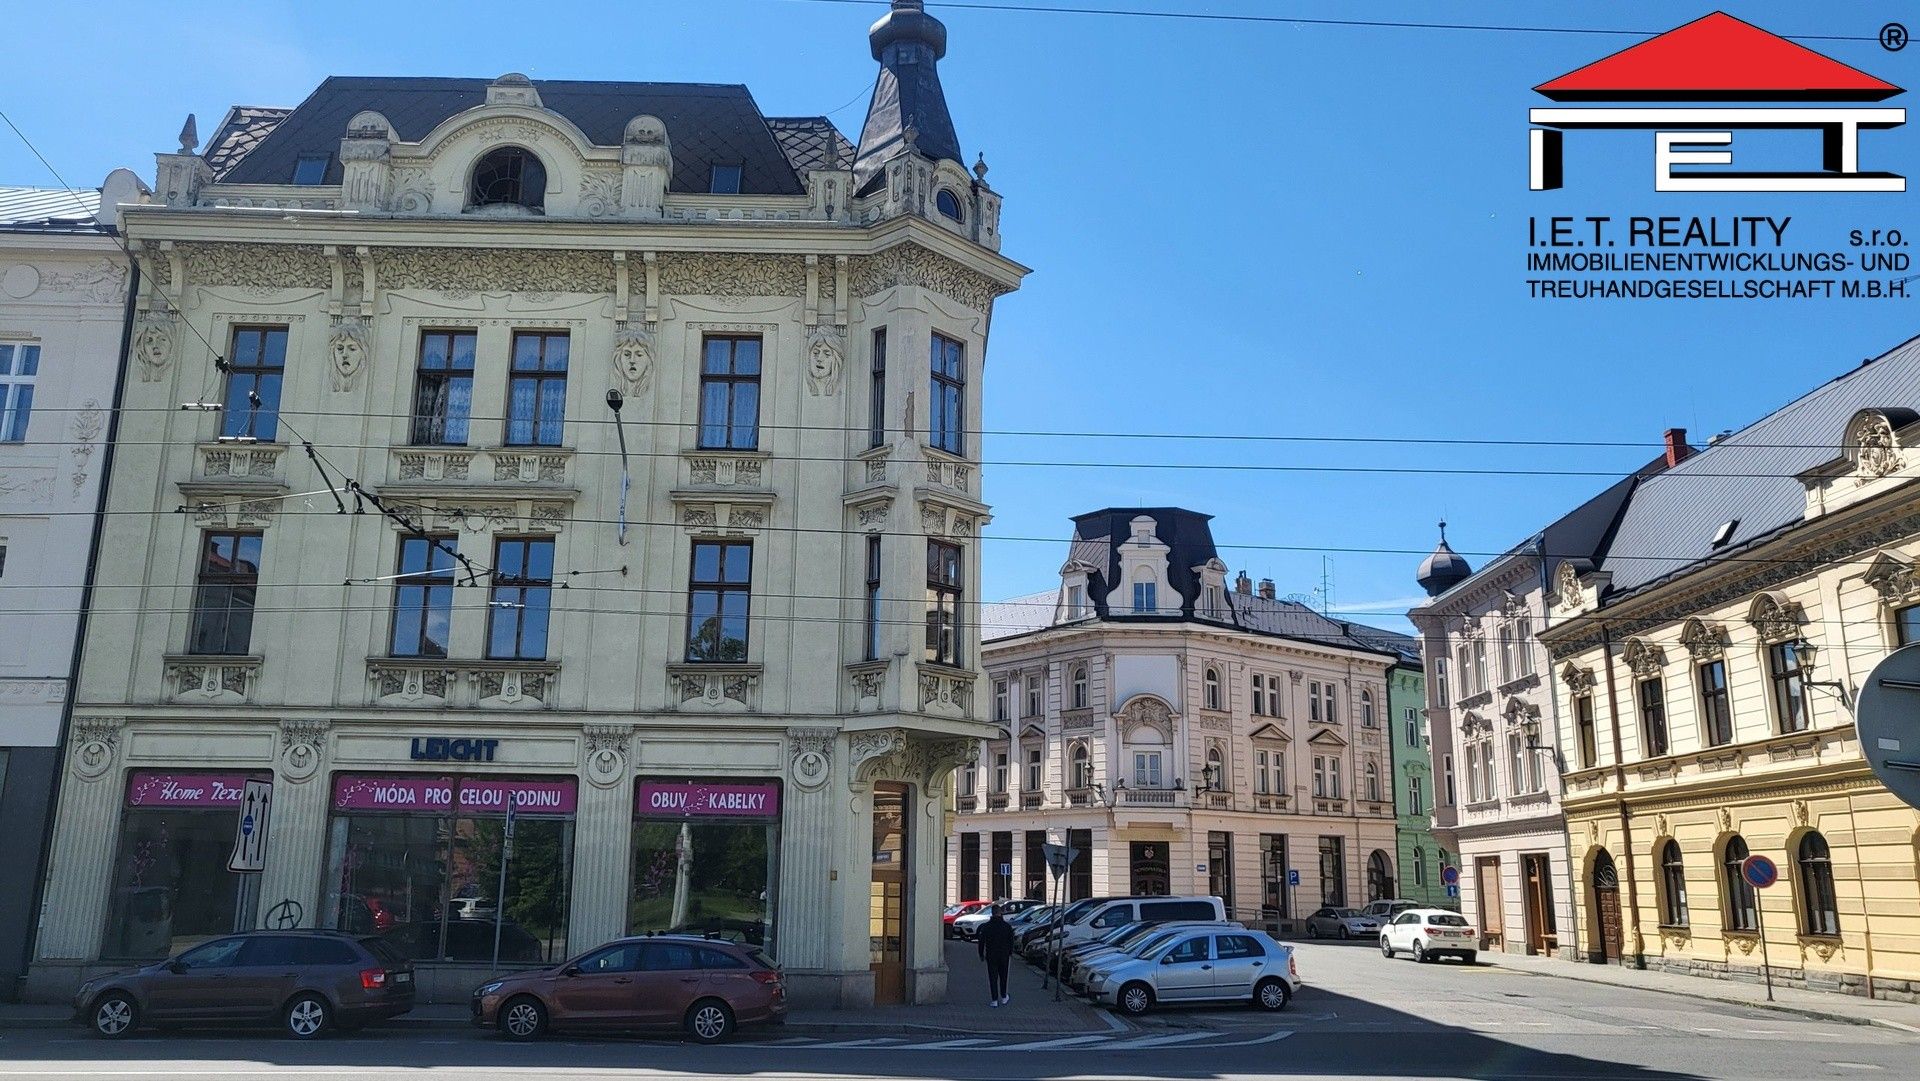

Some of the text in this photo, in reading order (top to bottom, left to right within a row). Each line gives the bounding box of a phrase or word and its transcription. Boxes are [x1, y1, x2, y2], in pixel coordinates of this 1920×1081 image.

[411, 737, 498, 761] LEICHT
[160, 781, 204, 800] Home
[374, 783, 416, 804] MÓDA
[424, 788, 452, 804] PRO
[459, 788, 502, 805] CELOU
[651, 792, 766, 809] OBUV KABELKY
[1290, 871, 1297, 881] P
